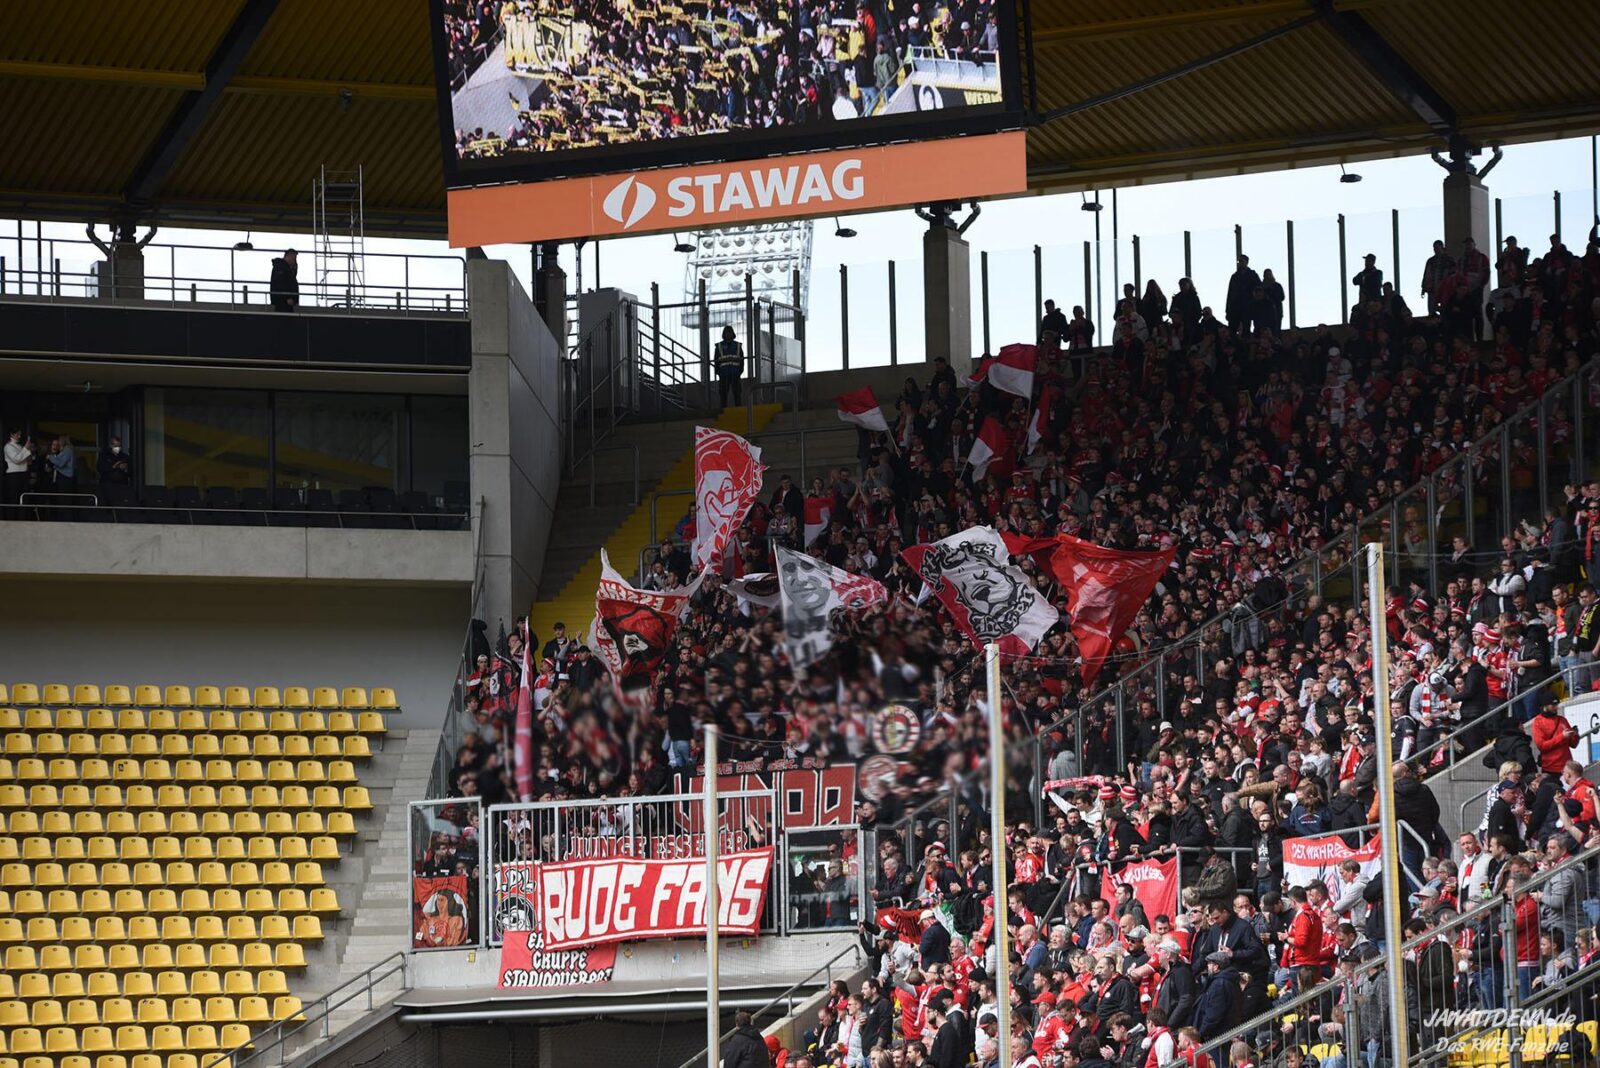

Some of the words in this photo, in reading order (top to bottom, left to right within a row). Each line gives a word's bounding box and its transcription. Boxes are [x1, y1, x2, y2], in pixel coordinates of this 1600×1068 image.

[666, 158, 865, 217] STAWAG
[650, 829, 748, 860] ESSEER
[542, 863, 648, 945] RUDE
[648, 857, 767, 929] FANS
